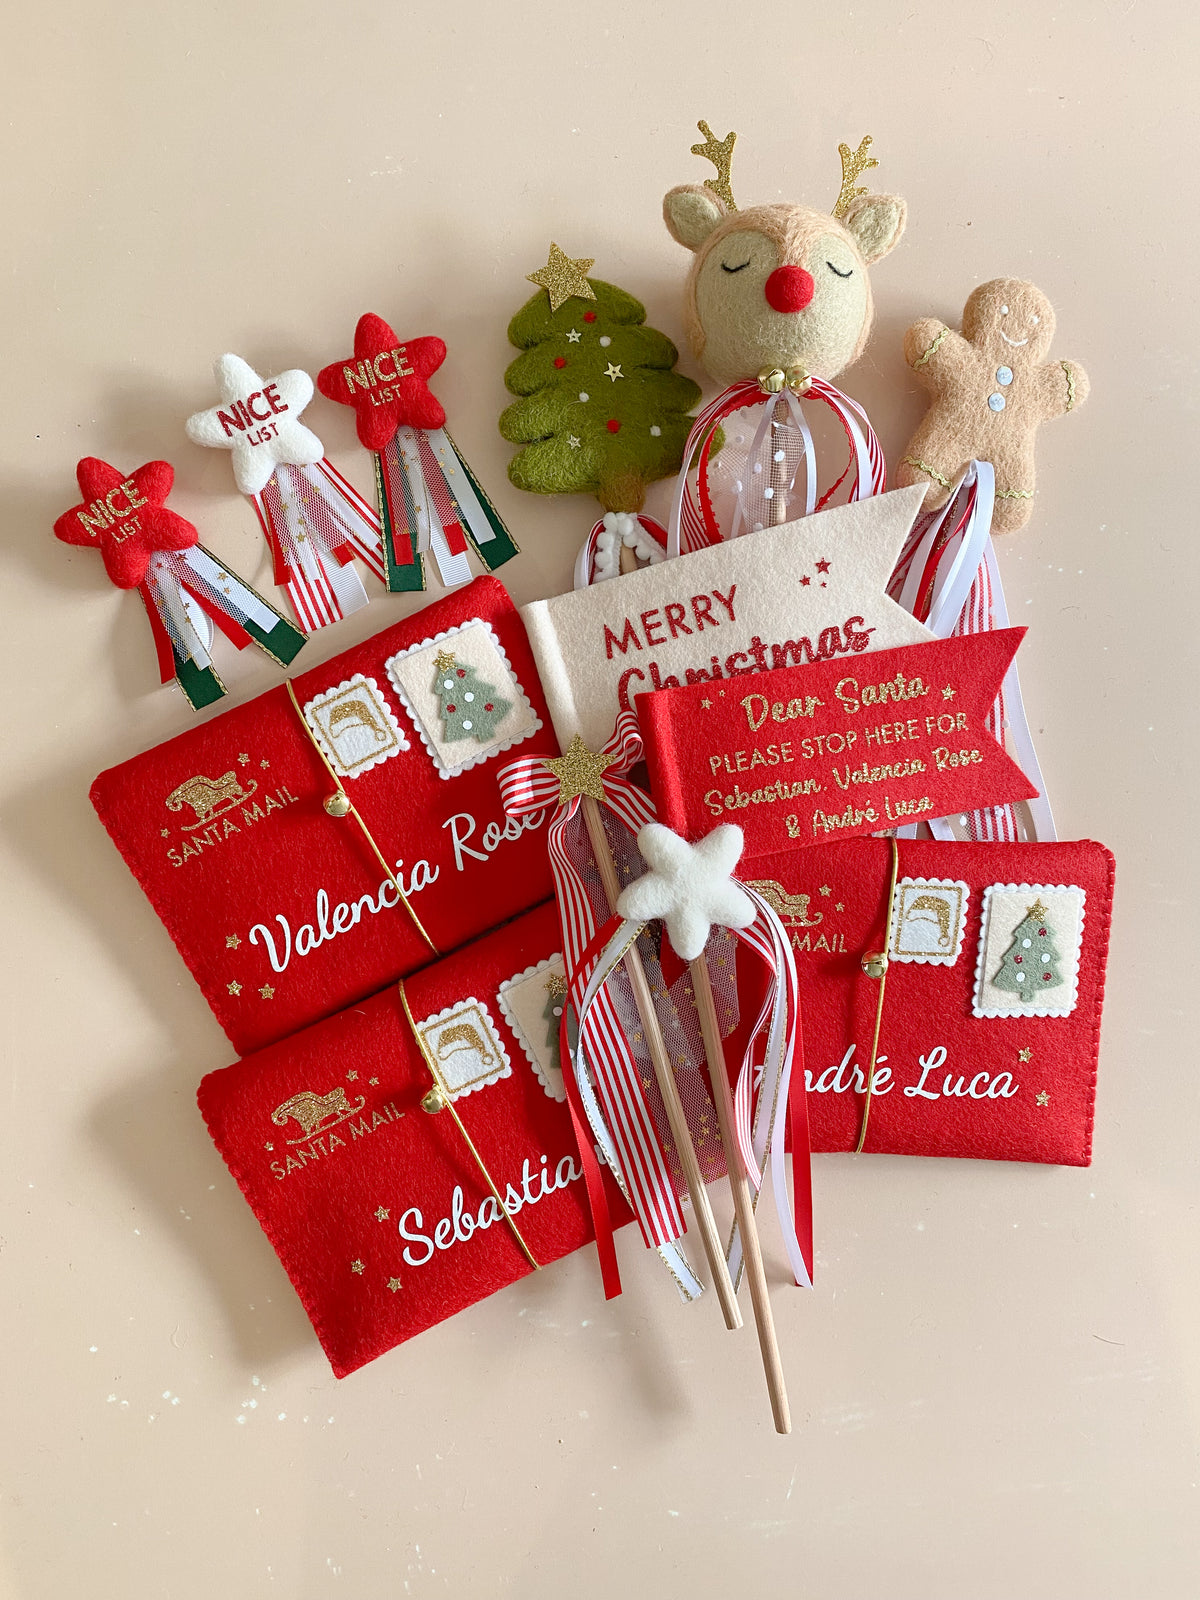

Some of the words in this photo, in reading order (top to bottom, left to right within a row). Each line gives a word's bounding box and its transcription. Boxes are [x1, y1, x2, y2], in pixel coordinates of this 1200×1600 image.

[343, 346, 415, 394] NICE
[369, 384, 402, 407] LIST
[216, 383, 289, 437] NICE
[246, 422, 280, 447] LIST
[76, 479, 149, 538] NICE
[111, 518, 143, 544] LIST
[603, 584, 738, 660] MERRY
[740, 691, 826, 733] Dear
[834, 673, 930, 714] Santa
[708, 741, 795, 776] PLEASE
[801, 729, 858, 760] STOP
[864, 719, 921, 748] HERE
[925, 712, 969, 737] FOR
[832, 757, 927, 791] Valencia
[931, 746, 985, 772] Rose
[166, 818, 242, 869] SANTA
[239, 784, 300, 827] MAIL
[785, 814, 801, 839] &
[811, 800, 880, 837] André
[884, 796, 935, 821] Luca
[248, 857, 440, 973] Valencia
[791, 931, 848, 953] MAIL
[754, 1043, 895, 1096] ndré
[903, 1045, 1020, 1100] Luca
[269, 1132, 346, 1181] SANTA
[348, 1101, 406, 1140] MAIL
